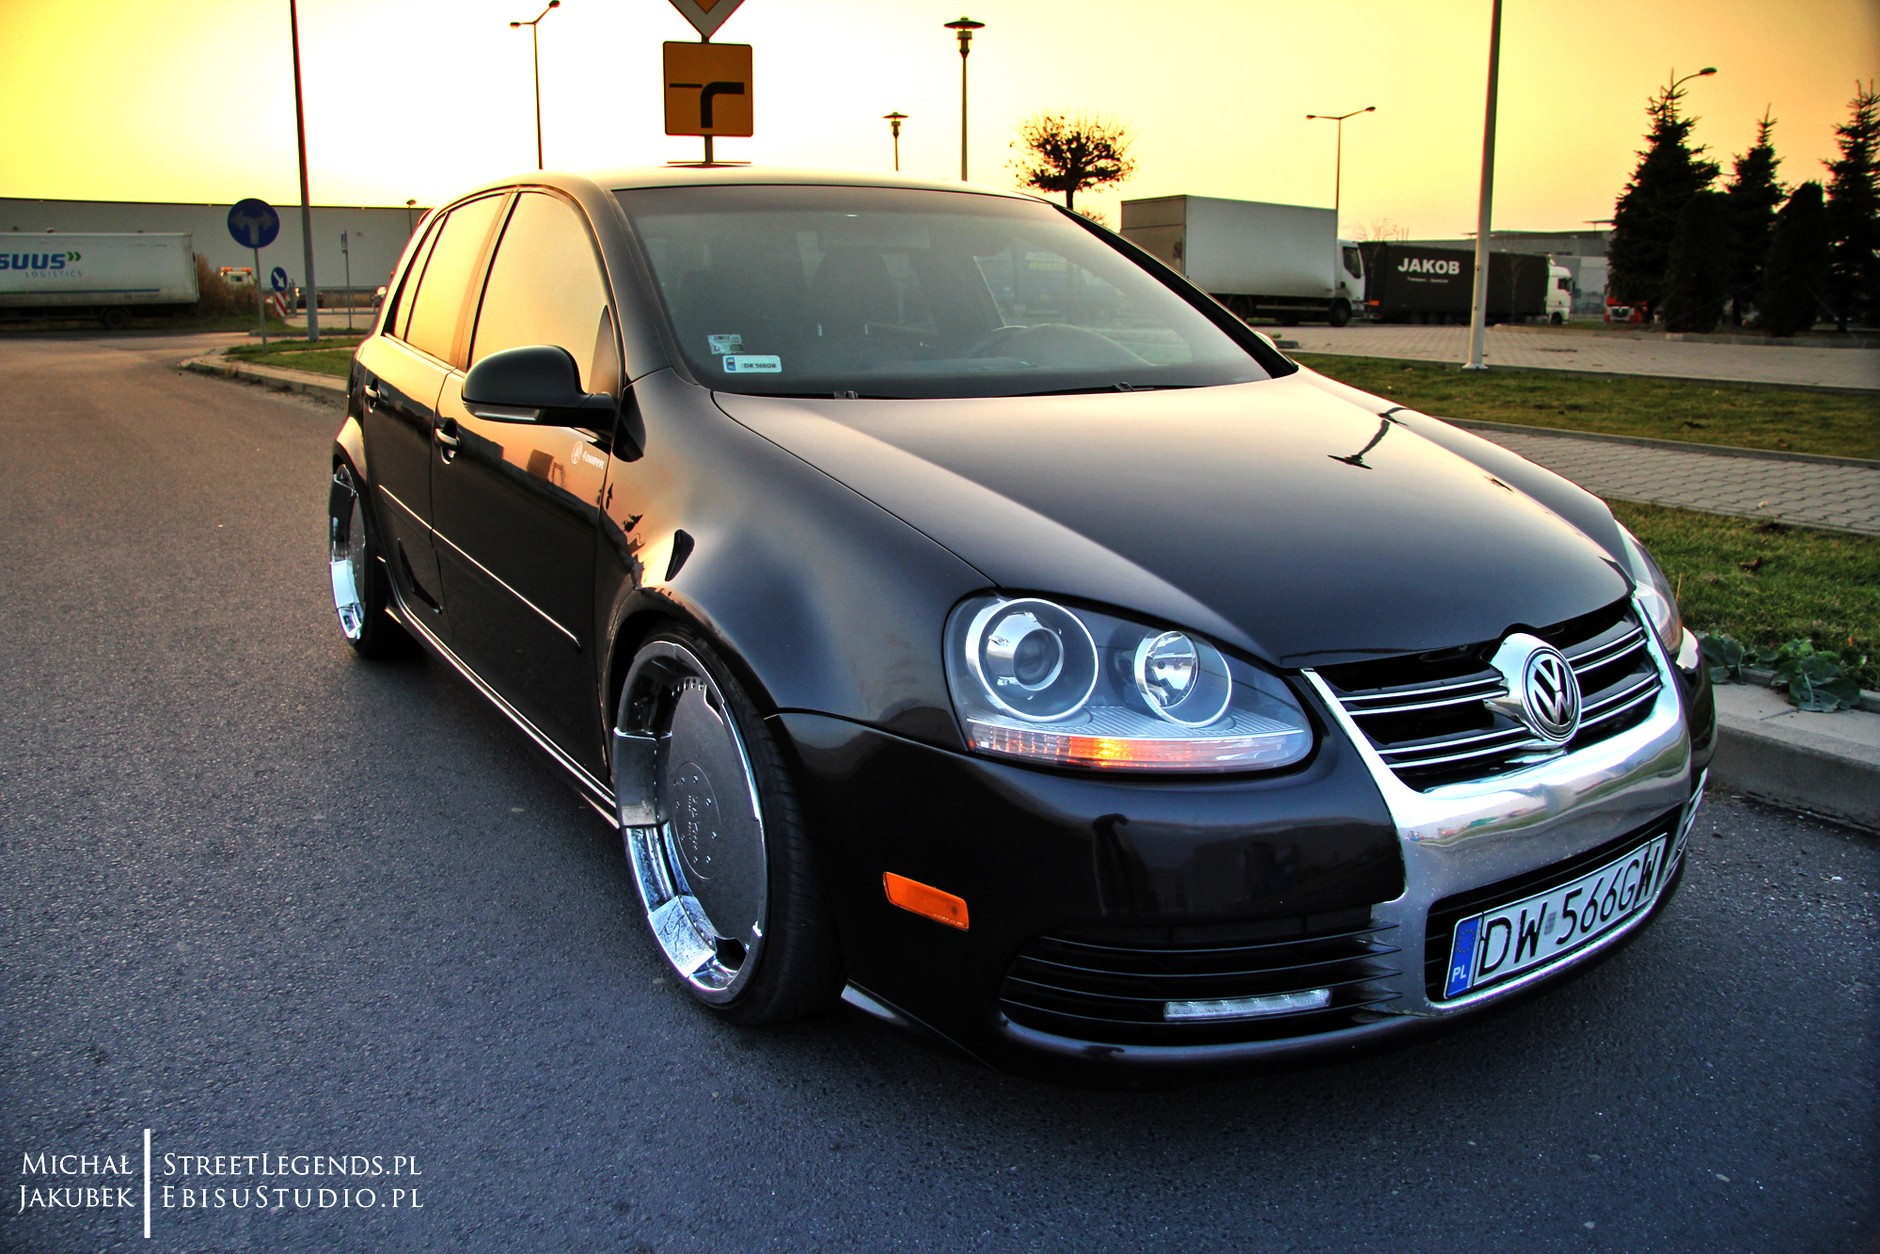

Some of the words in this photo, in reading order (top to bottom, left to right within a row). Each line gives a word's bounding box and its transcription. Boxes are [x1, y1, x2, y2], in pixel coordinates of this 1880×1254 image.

[25, 270, 83, 278] LOGISTICS
[1397, 257, 1460, 275] JAKOB
[1478, 901, 1548, 977] DW
[1556, 846, 1661, 945] 566GW
[1450, 966, 1468, 984] PL
